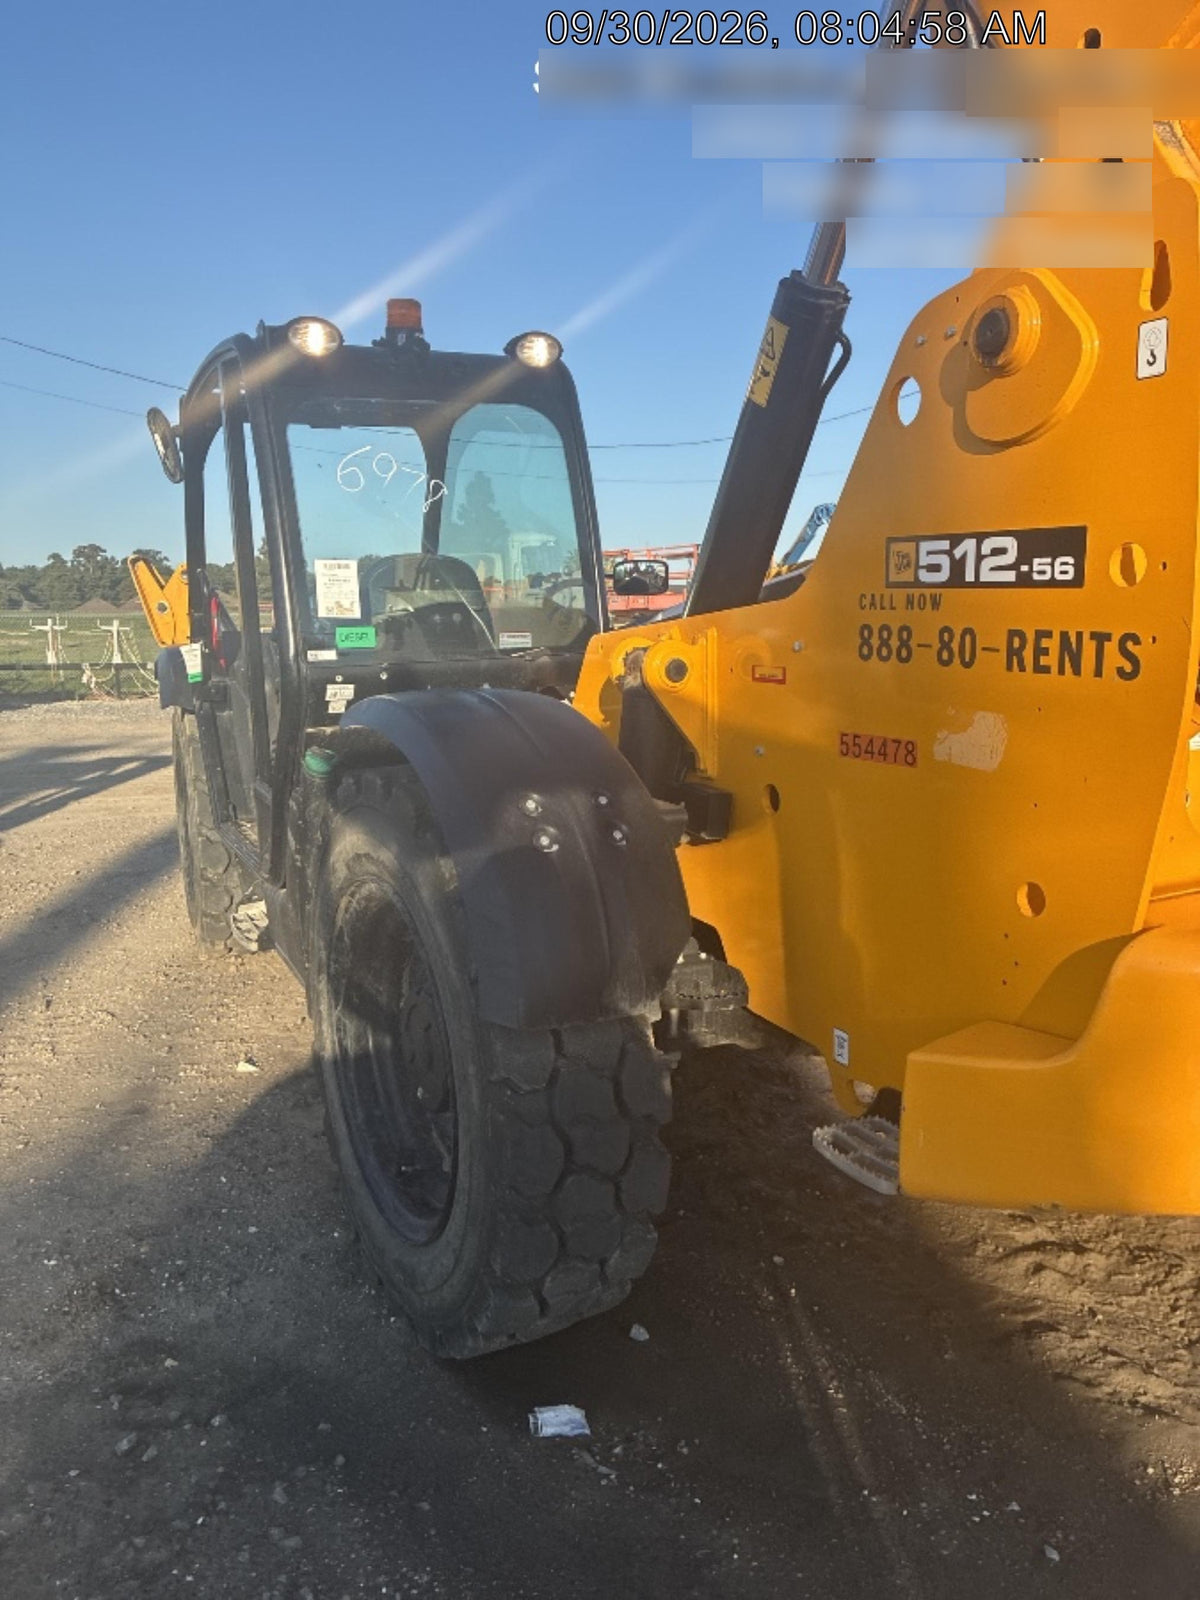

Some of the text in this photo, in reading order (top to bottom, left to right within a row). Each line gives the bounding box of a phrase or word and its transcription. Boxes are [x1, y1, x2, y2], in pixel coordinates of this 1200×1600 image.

[917, 536, 1075, 583] 512-56
[859, 592, 942, 612] CALL NOW
[858, 623, 1142, 681] 888-80-RENTS
[839, 732, 917, 767] 554478
